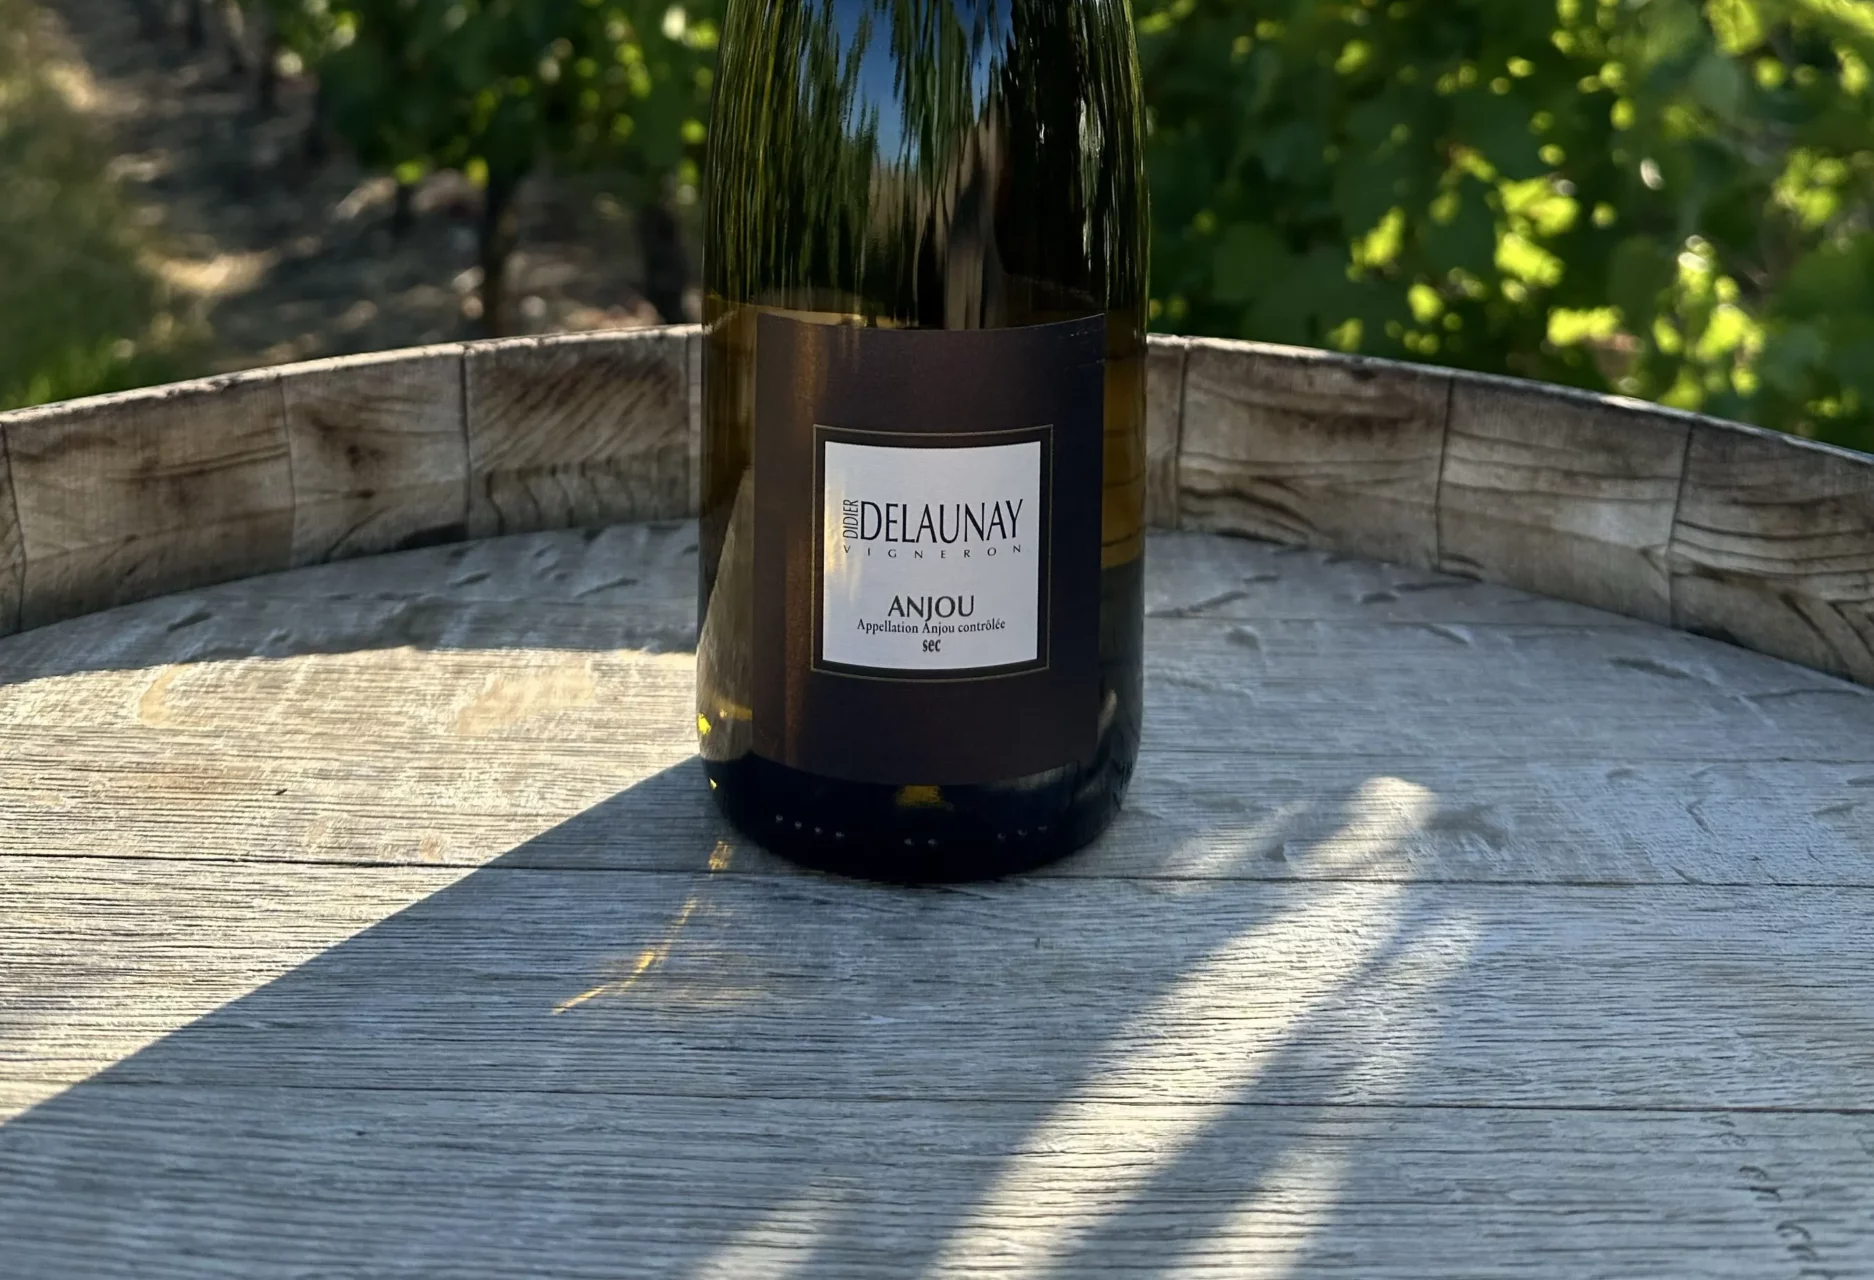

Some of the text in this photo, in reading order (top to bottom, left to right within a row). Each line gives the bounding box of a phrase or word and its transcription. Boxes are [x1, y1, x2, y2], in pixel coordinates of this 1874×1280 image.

[842, 499, 859, 539] DIDIER
[860, 499, 1023, 544] DELAUNAY
[843, 544, 1021, 559] VIGNERON
[888, 594, 975, 621] ANJOU
[857, 618, 1006, 636] Appellation Anjou contrôlée
[922, 638, 941, 653] sec
